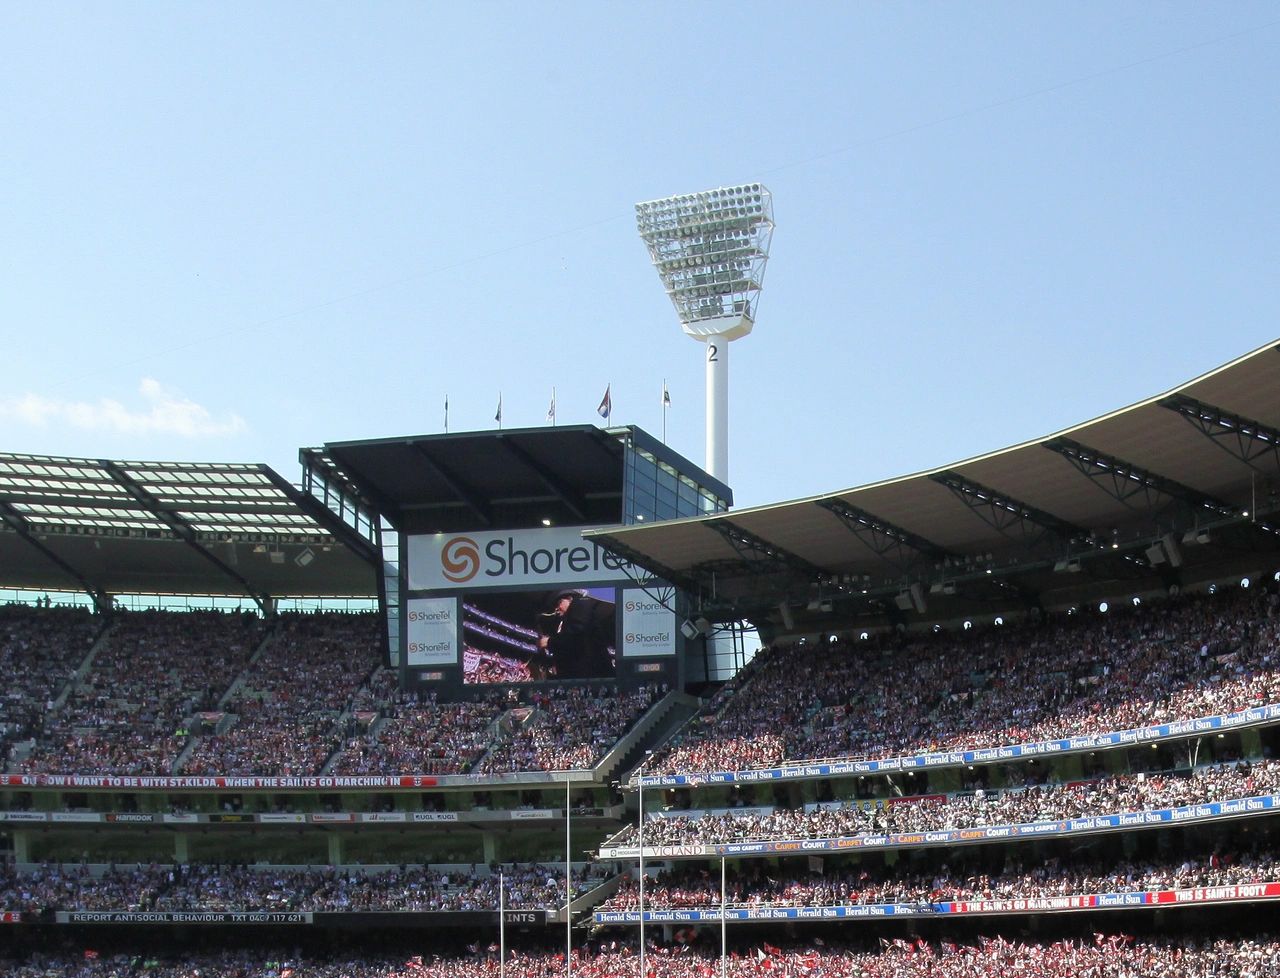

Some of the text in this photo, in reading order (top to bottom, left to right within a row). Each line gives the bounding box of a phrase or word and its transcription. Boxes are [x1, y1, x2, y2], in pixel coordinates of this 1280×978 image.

[708, 345, 718, 361] 2
[635, 632, 670, 643] ShoreTel
[418, 641, 450, 652] ShoreTel
[73, 777, 105, 785] WANT
[107, 778, 120, 786] TO
[124, 778, 138, 786] BE
[140, 778, 167, 786] WITH
[224, 778, 255, 786] WHEN
[257, 778, 277, 786] THE
[280, 778, 317, 786] SAINTS
[319, 778, 332, 786] GO
[335, 778, 387, 786] MARCHING
[390, 778, 400, 786] IN
[1247, 799, 1263, 810] Sun
[1196, 805, 1211, 816] Sun
[1095, 817, 1110, 827] Sun
[1146, 812, 1161, 822] Sun
[960, 826, 1009, 839] CARPET COURT
[1035, 823, 1057, 832] CARPET
[838, 836, 886, 847] CARPET COURT
[898, 831, 949, 843] CARPET COURT
[775, 840, 826, 850] CARPET COURT
[1125, 894, 1140, 903] Sun
[1175, 885, 1267, 901] THIS IS SAINTS FOOTY
[966, 901, 980, 911] THE
[1013, 899, 1025, 910] GO
[1027, 897, 1069, 910] MARCHING
[1071, 896, 1080, 907] IN
